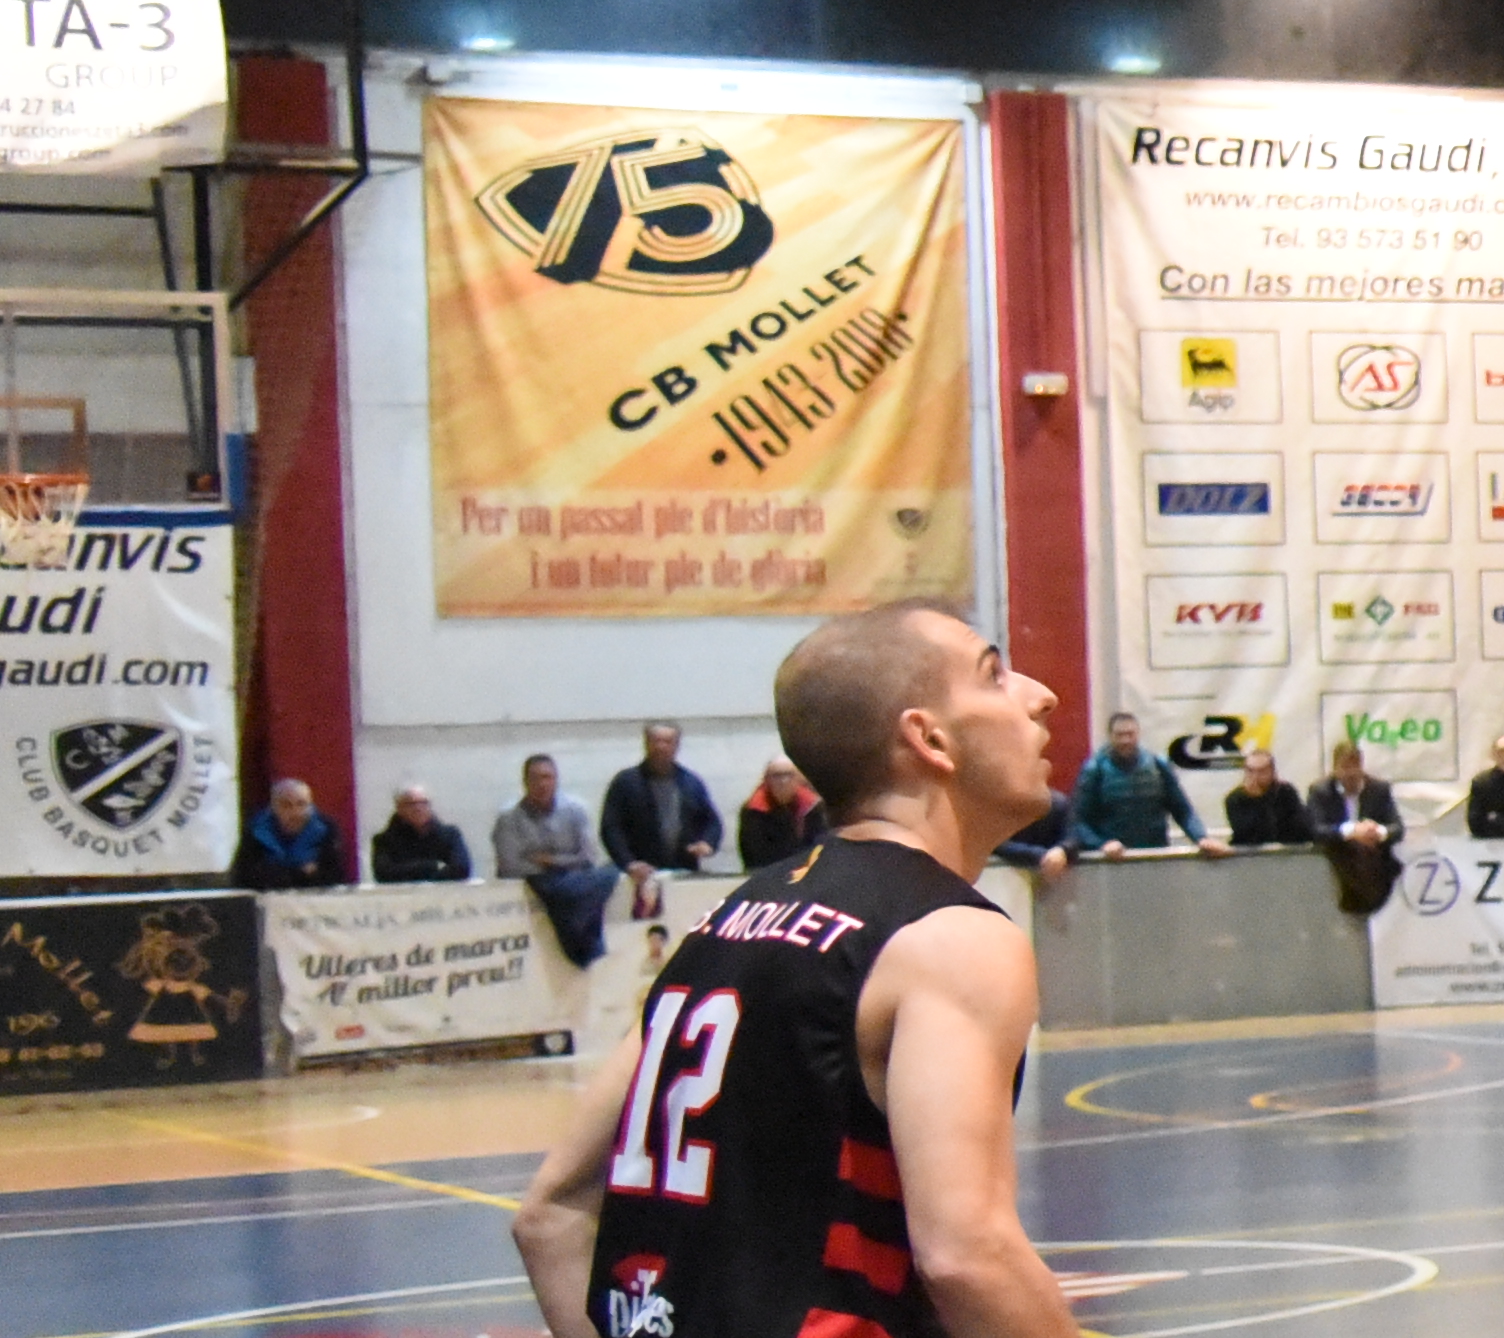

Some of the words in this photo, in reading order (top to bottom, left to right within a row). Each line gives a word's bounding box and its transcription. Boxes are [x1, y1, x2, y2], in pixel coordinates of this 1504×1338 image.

[46, 63, 177, 88] GROUP
[1133, 127, 1338, 170] Recanvis
[1262, 227, 1304, 249] Tel.
[1317, 228, 1348, 249] 93
[1358, 229, 1405, 250] 573
[1413, 231, 1441, 250] 51
[1453, 231, 1483, 251] 90
[1160, 265, 1230, 296] Con
[1245, 269, 1292, 296] las
[1306, 268, 1444, 302] mejores
[608, 366, 698, 431] CB
[704, 255, 876, 372] MOLLET
[462, 498, 508, 534] Per
[0, 654, 209, 687] audi.com
[718, 900, 864, 953] MOLLET
[607, 984, 743, 1206] 12
